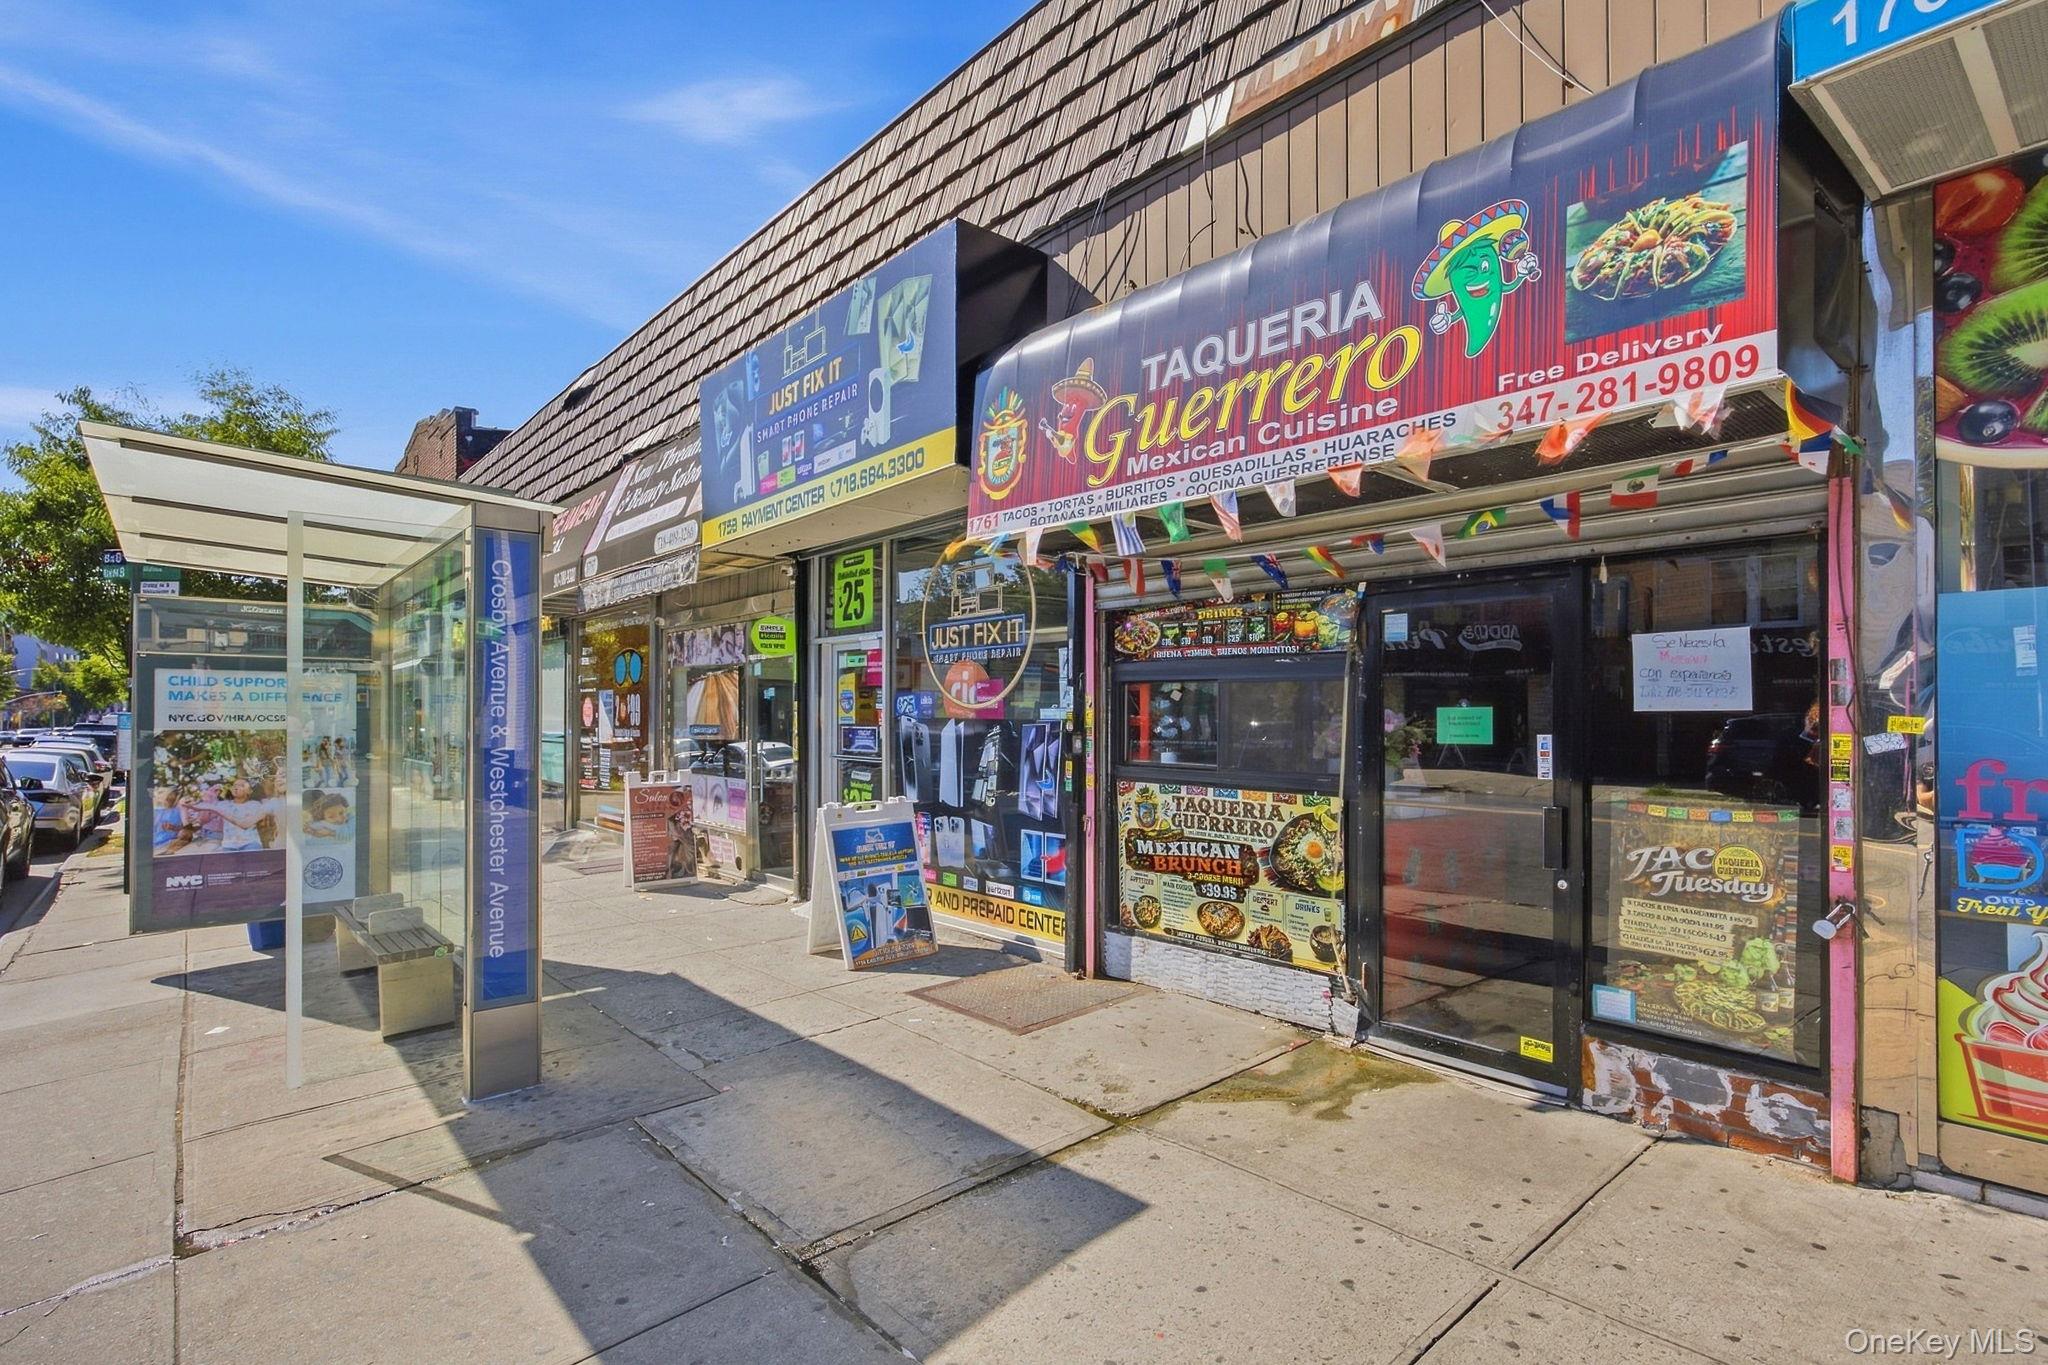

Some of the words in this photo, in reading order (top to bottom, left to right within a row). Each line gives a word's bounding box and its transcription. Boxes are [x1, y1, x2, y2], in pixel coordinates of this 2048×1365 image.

[1812, 0, 1948, 46] 17
[1142, 280, 1385, 391] TAQUERIA
[1498, 362, 1565, 392] Free
[1576, 322, 1724, 375] Delivery
[769, 380, 800, 415] JUST
[803, 366, 825, 398] FIX
[829, 356, 842, 384] IT
[1497, 344, 1760, 431] 347-281-9809
[787, 402, 819, 428] PHONE
[822, 383, 858, 412] REPAIR
[1085, 324, 1423, 488] Guerrero
[1126, 434, 1245, 477] Mexican
[1257, 397, 1399, 443] Cuisine
[1002, 506, 1037, 522] TACOS
[1048, 494, 1094, 513] TORTAS
[1106, 476, 1176, 501] BURRITOS
[1189, 447, 1306, 483] QUESADILLAS
[1323, 412, 1457, 455] HUARACHES
[1030, 509, 1085, 527] BOTANAS
[1089, 491, 1167, 516] FAMILIARES
[1185, 477, 1246, 497] COCINA
[1251, 443, 1395, 484] GUERRERENSE
[742, 502, 783, 529] PAYMENT
[785, 485, 825, 513] CENTER
[969, 515, 999, 532] 1761
[491, 559, 511, 634] Crosby
[838, 579, 865, 621] $25
[1198, 608, 1243, 620] DRINKS
[931, 624, 969, 650] JUST
[974, 622, 1002, 646] FIX
[1007, 618, 1022, 643] IT
[1216, 647, 1248, 656] BUENOS
[1250, 645, 1300, 654] MOMENTOS!
[1652, 634, 1676, 649] Se
[991, 647, 1021, 659] REPAIR
[167, 676, 218, 687] CHILD
[223, 677, 287, 687] SUPPOR
[490, 640, 510, 718] Avenue
[168, 691, 227, 701] MAKES
[232, 691, 244, 701] A
[249, 692, 343, 703] DIFFENCE
[490, 725, 509, 739] &
[489, 748, 510, 875] Westchester
[635, 789, 669, 804] Salon
[1172, 796, 1285, 822] TAQUERIA
[1171, 813, 1278, 838] GUERRERO
[166, 875, 203, 888] NYC
[1153, 856, 1242, 875] BRUNCH
[1717, 866, 1761, 877] GUERRERO
[1650, 870, 1775, 903] Tuesday
[489, 881, 509, 958] Avenue
[935, 890, 959, 910] AND
[962, 896, 1014, 924] PREPAID
[1295, 903, 1320, 913] DRINKS
[1633, 901, 1656, 910] TACOS
[1680, 907, 1728, 921] MARGARITA
